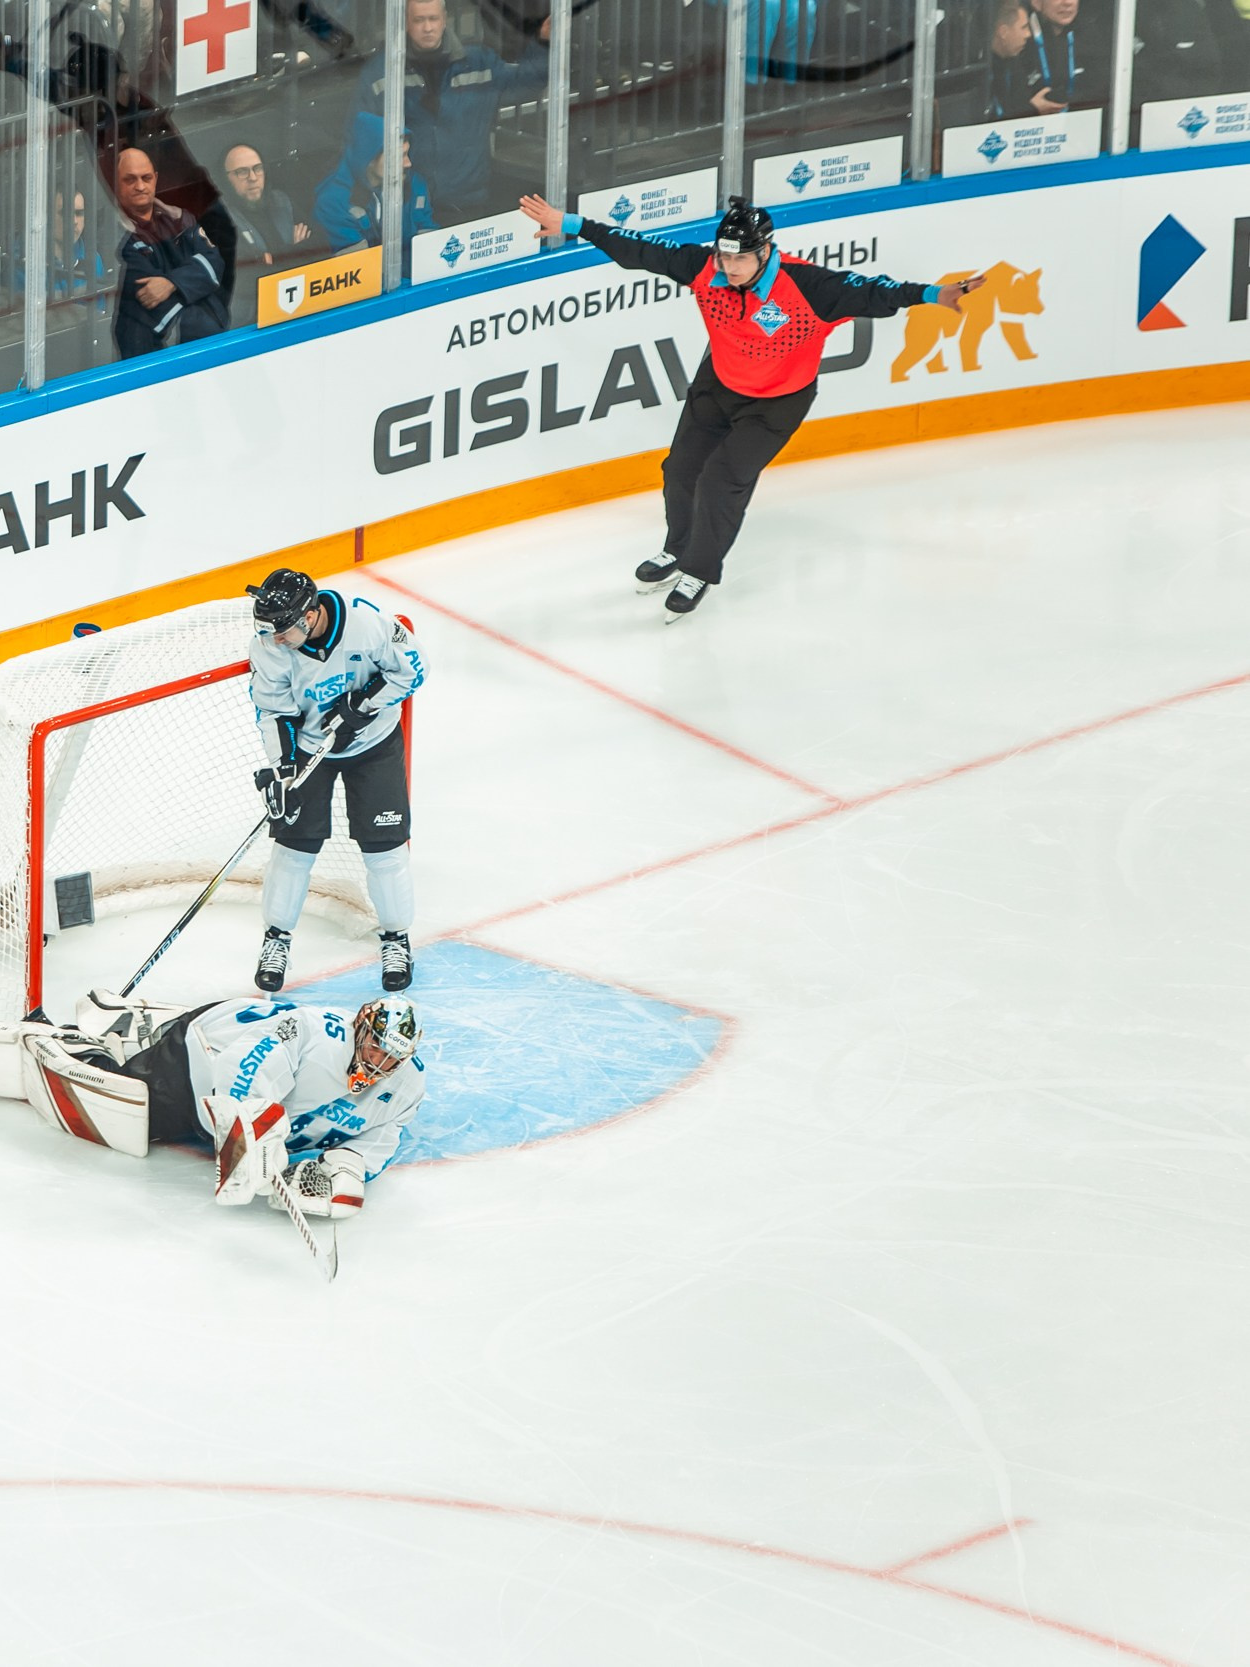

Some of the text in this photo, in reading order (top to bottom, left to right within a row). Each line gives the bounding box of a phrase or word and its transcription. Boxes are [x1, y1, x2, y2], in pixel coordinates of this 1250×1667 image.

[821, 155, 849, 167] ФОНБЕТ
[821, 161, 870, 177] НЕДЕЛЯ ЗВЕЗД
[820, 173, 865, 187] ХОККЕЯ 2025
[641, 188, 668, 201] ФОНБЕТ
[641, 194, 688, 211] НЕДЕЛЯ ЗВЕЗД
[640, 205, 683, 221] ХОККЕЯ 2025
[470, 227, 495, 240] ФОНБЕТ
[470, 232, 514, 250] НЕДЕЛЯ ЗВЕЗД
[469, 243, 509, 260] ХОККЕЯ 2025
[787, 236, 878, 269] ИНЫ
[310, 268, 362, 297] БАНК
[373, 317, 874, 476] GISLAVD
